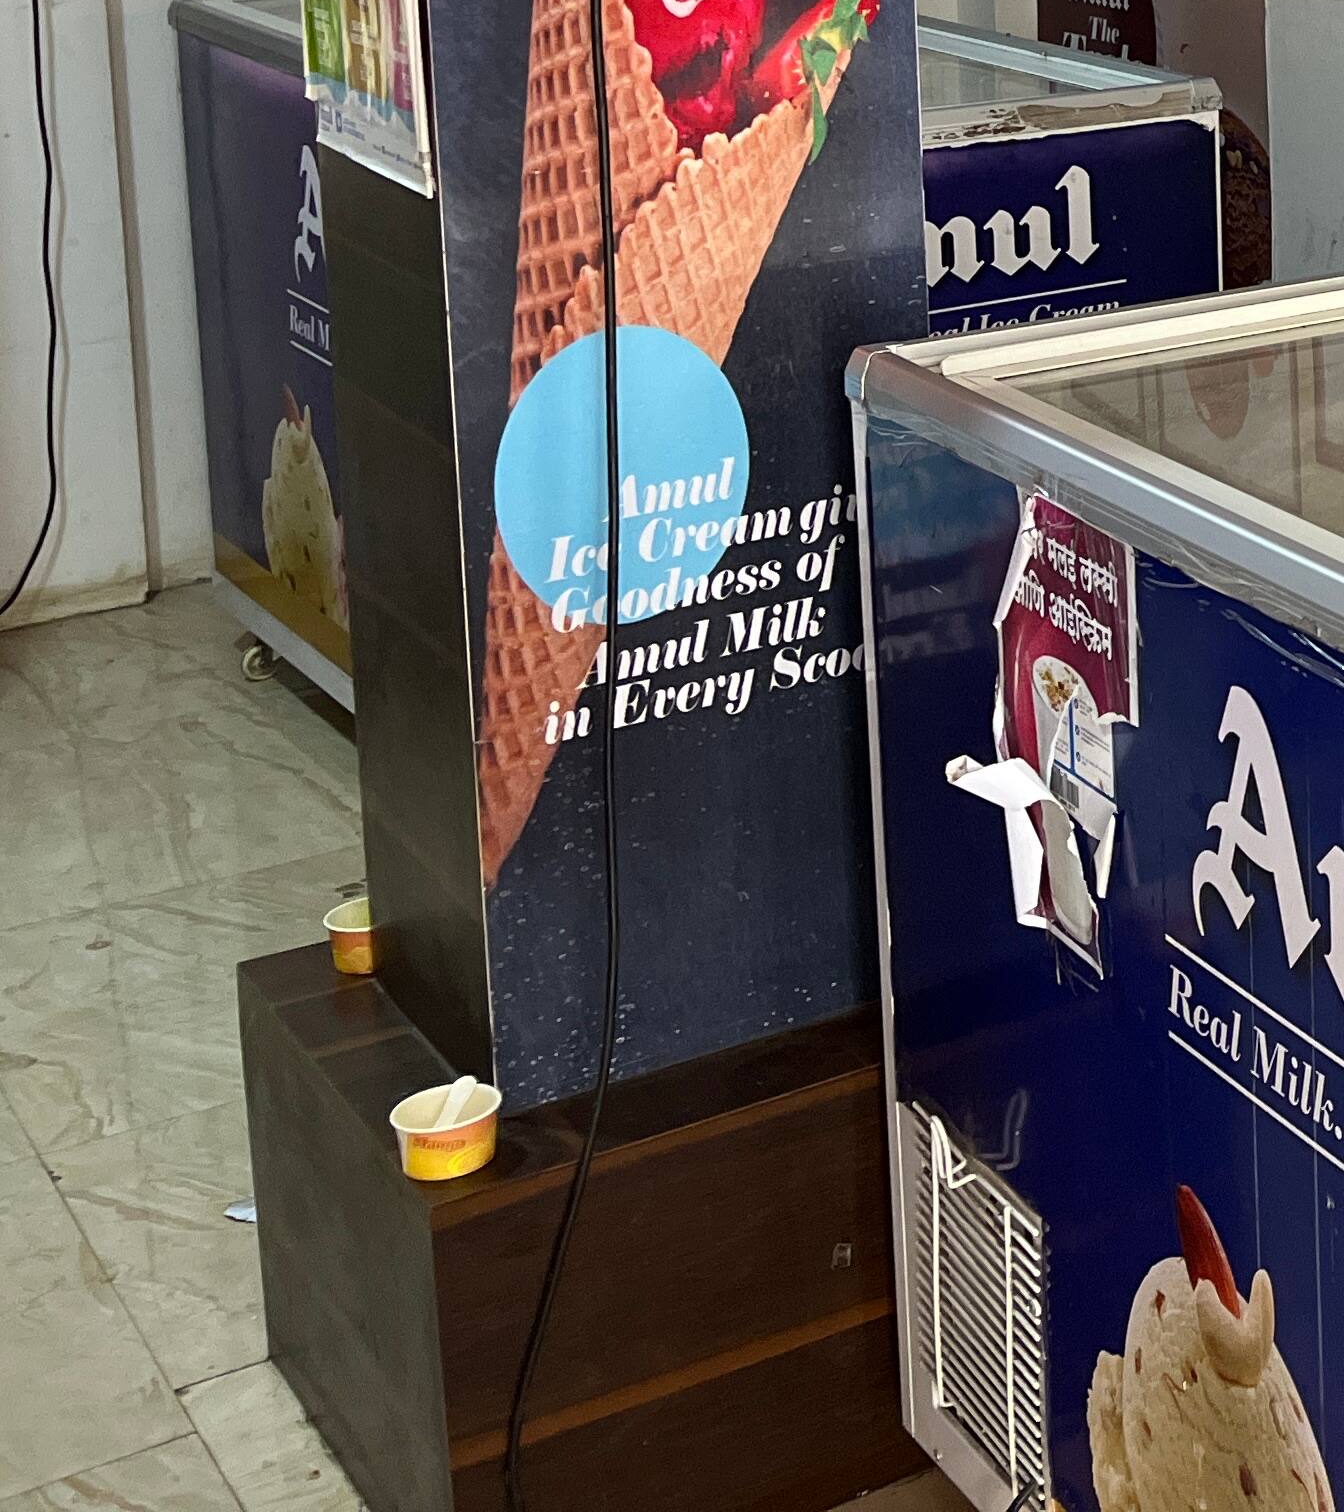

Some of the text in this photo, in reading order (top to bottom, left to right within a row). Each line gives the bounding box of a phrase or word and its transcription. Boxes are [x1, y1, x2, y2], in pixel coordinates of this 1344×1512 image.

[1087, 15, 1120, 44] The
[924, 164, 1100, 288] mul
[602, 456, 735, 525] Amul
[543, 505, 794, 586] Ice Cream
[550, 535, 846, 635] Goodness of
[575, 596, 828, 691] Amul Milk
[543, 701, 593, 745] in
[613, 666, 755, 730] Every
[1168, 963, 1242, 1064] Real
[1251, 1025, 1344, 1142] Milk.
